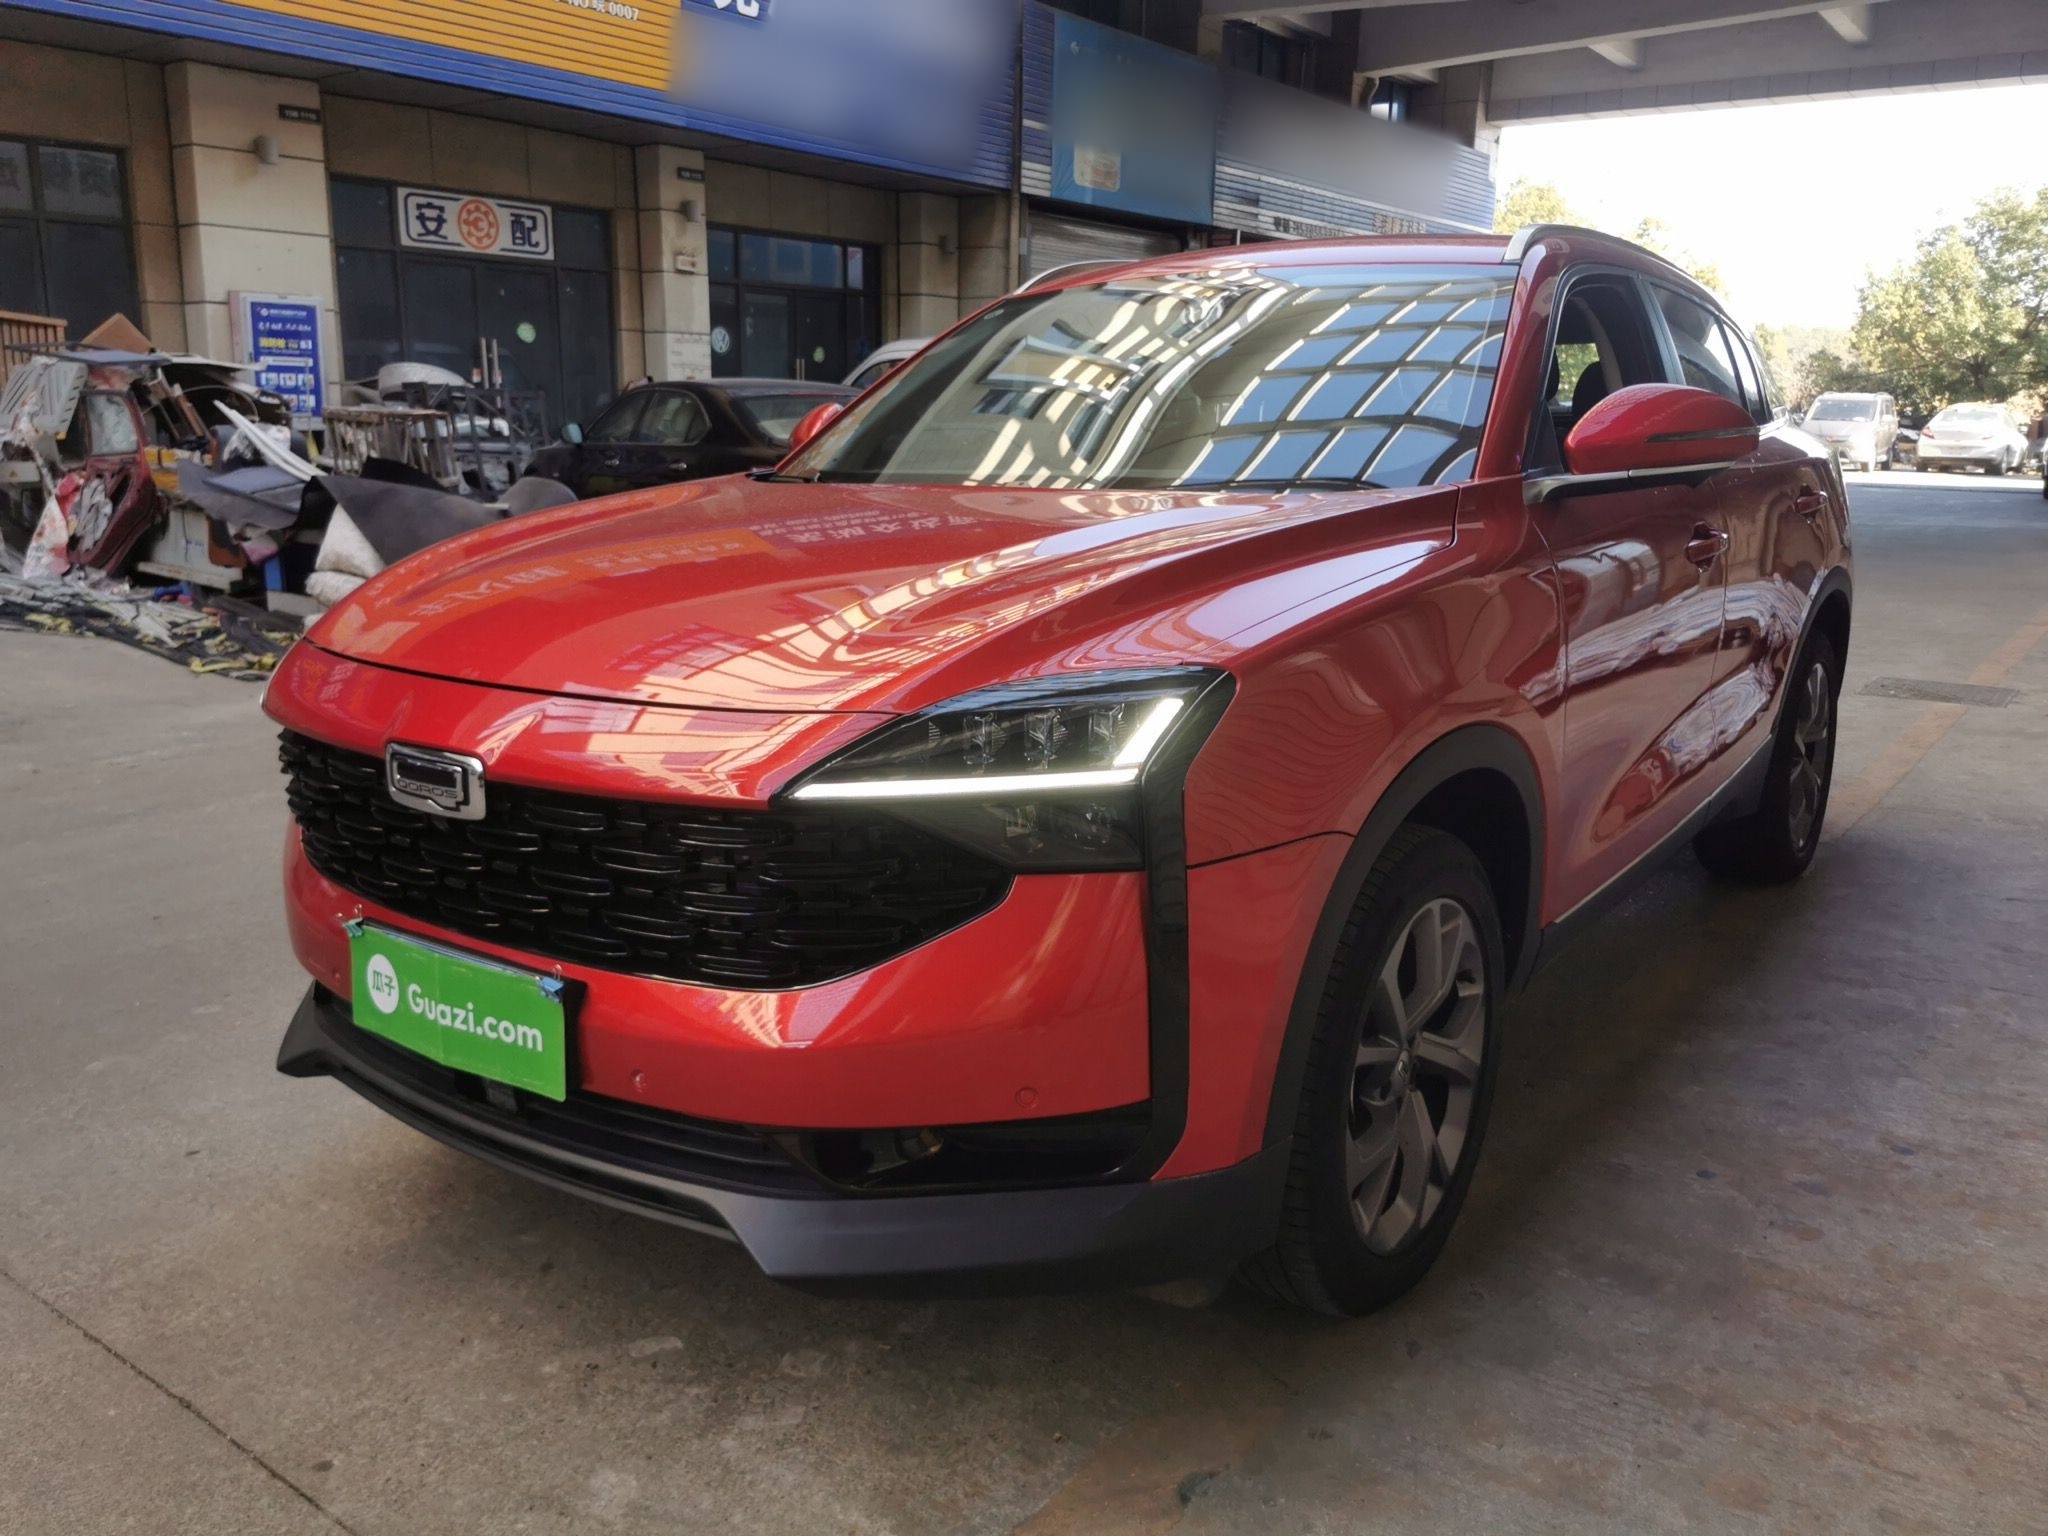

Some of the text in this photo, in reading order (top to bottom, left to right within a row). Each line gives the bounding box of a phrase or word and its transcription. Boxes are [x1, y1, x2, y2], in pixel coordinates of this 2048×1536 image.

[608, 2, 640, 20] 0007
[416, 202, 540, 248] 安 配
[372, 969, 396, 997] 瓜子
[408, 983, 543, 1052] Guazi.com
